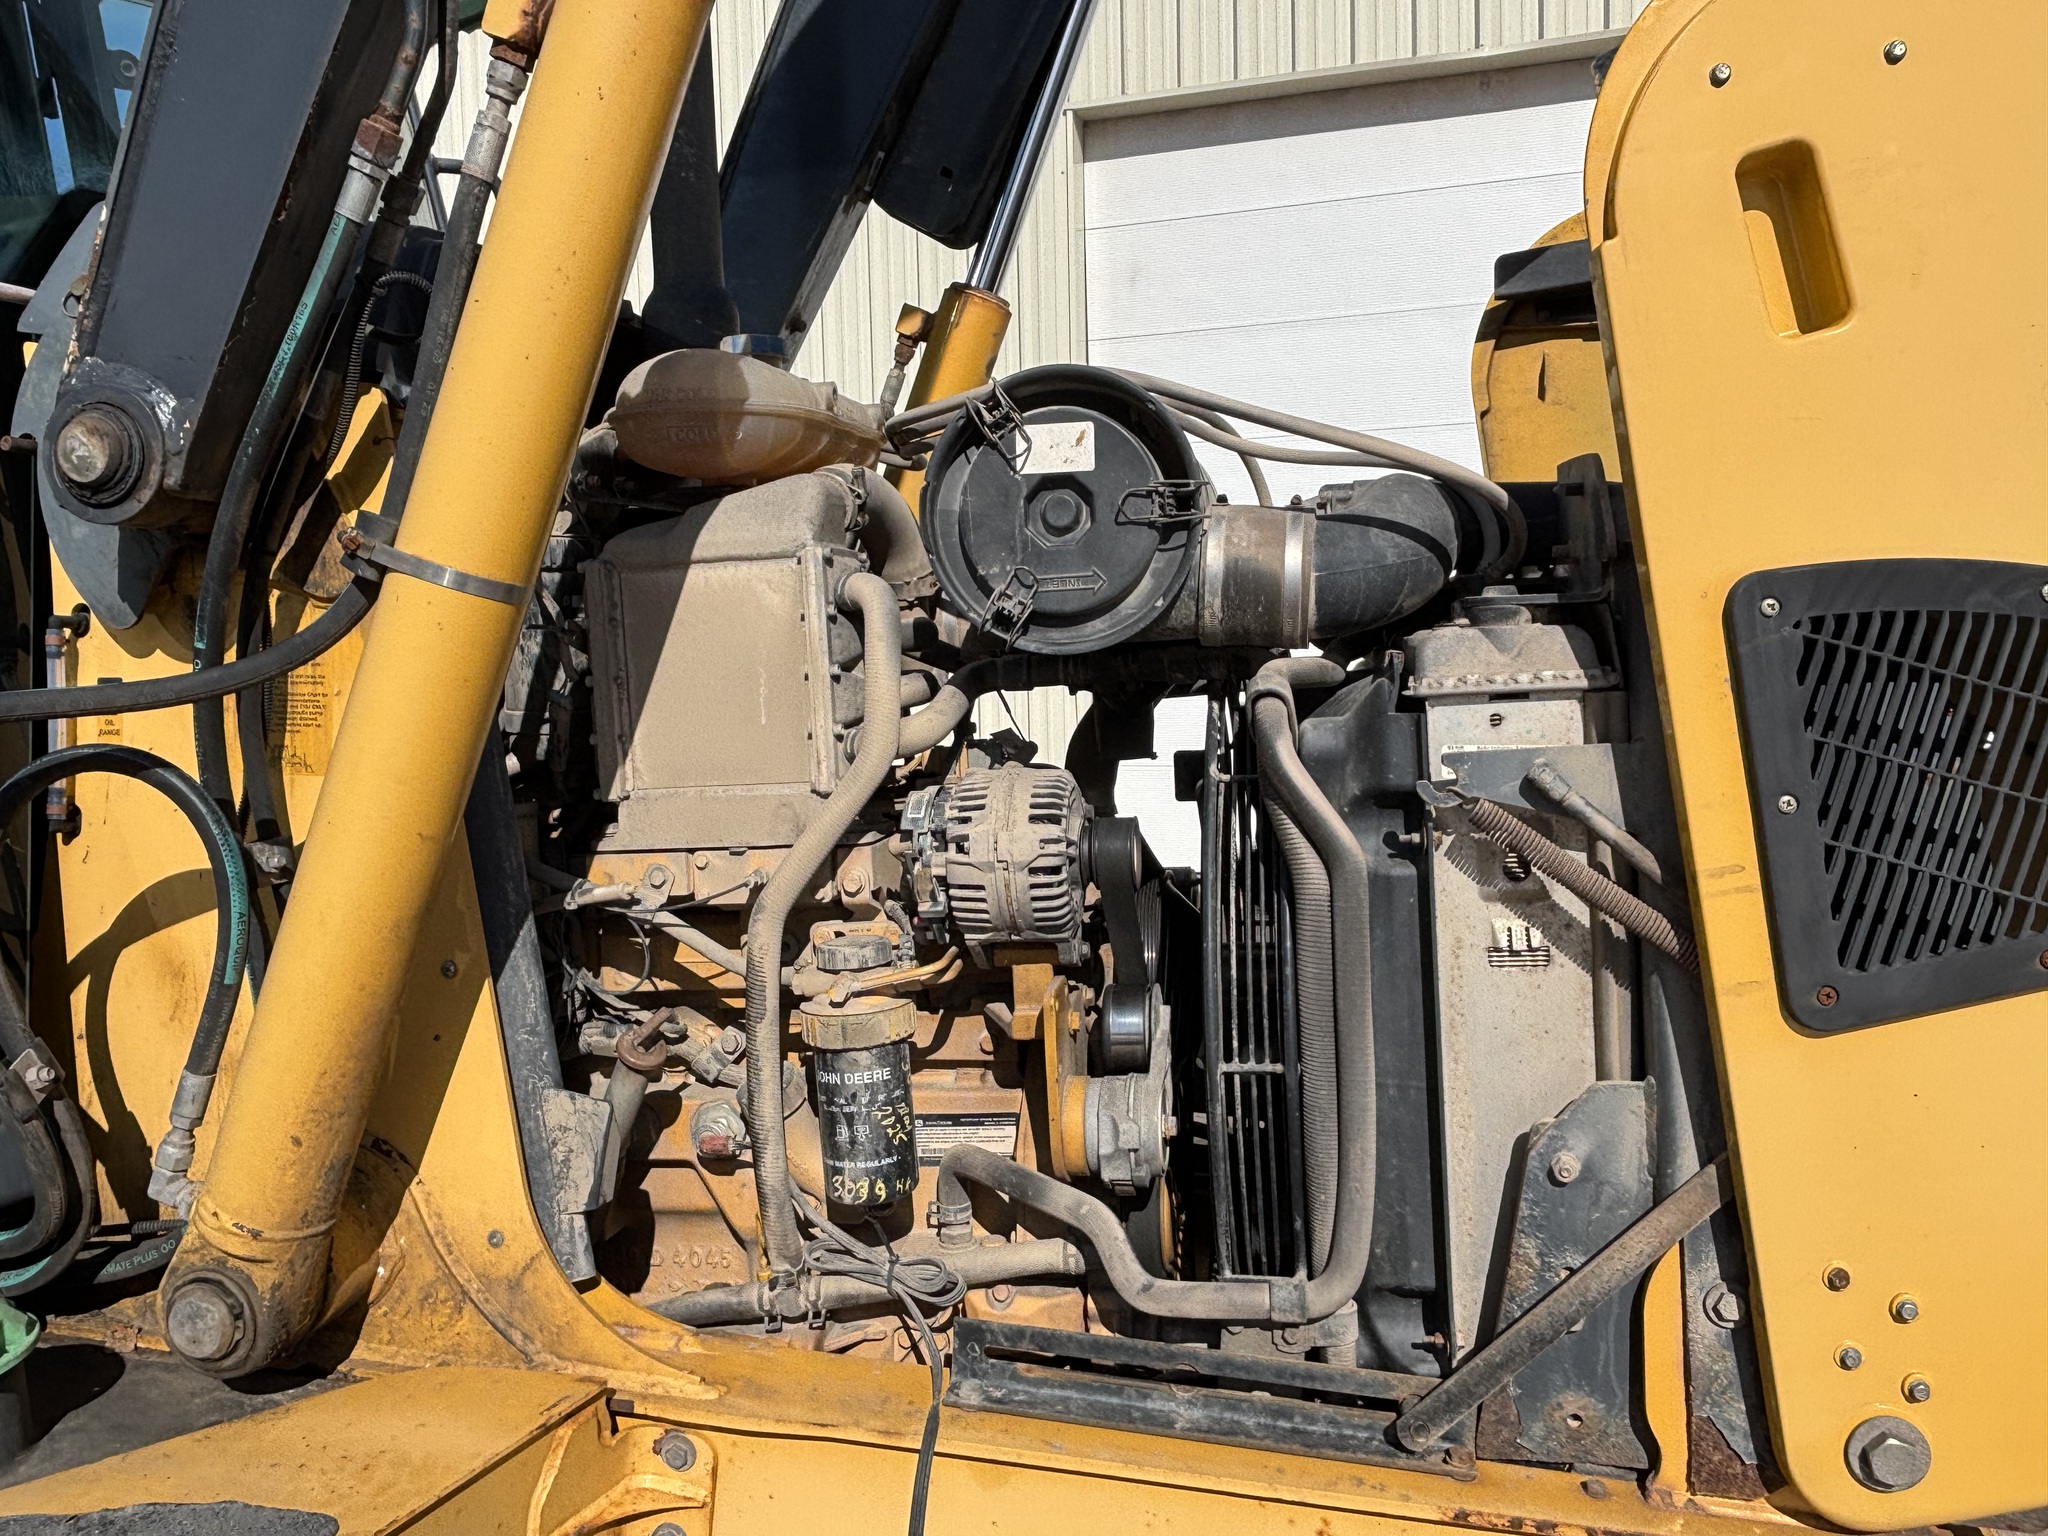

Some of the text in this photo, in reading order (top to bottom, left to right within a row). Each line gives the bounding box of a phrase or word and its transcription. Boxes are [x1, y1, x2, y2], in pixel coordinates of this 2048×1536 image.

[99, 728, 120, 736] RANGE
[844, 1067, 892, 1085] DEERE
[132, 1249, 159, 1266] PLUS
